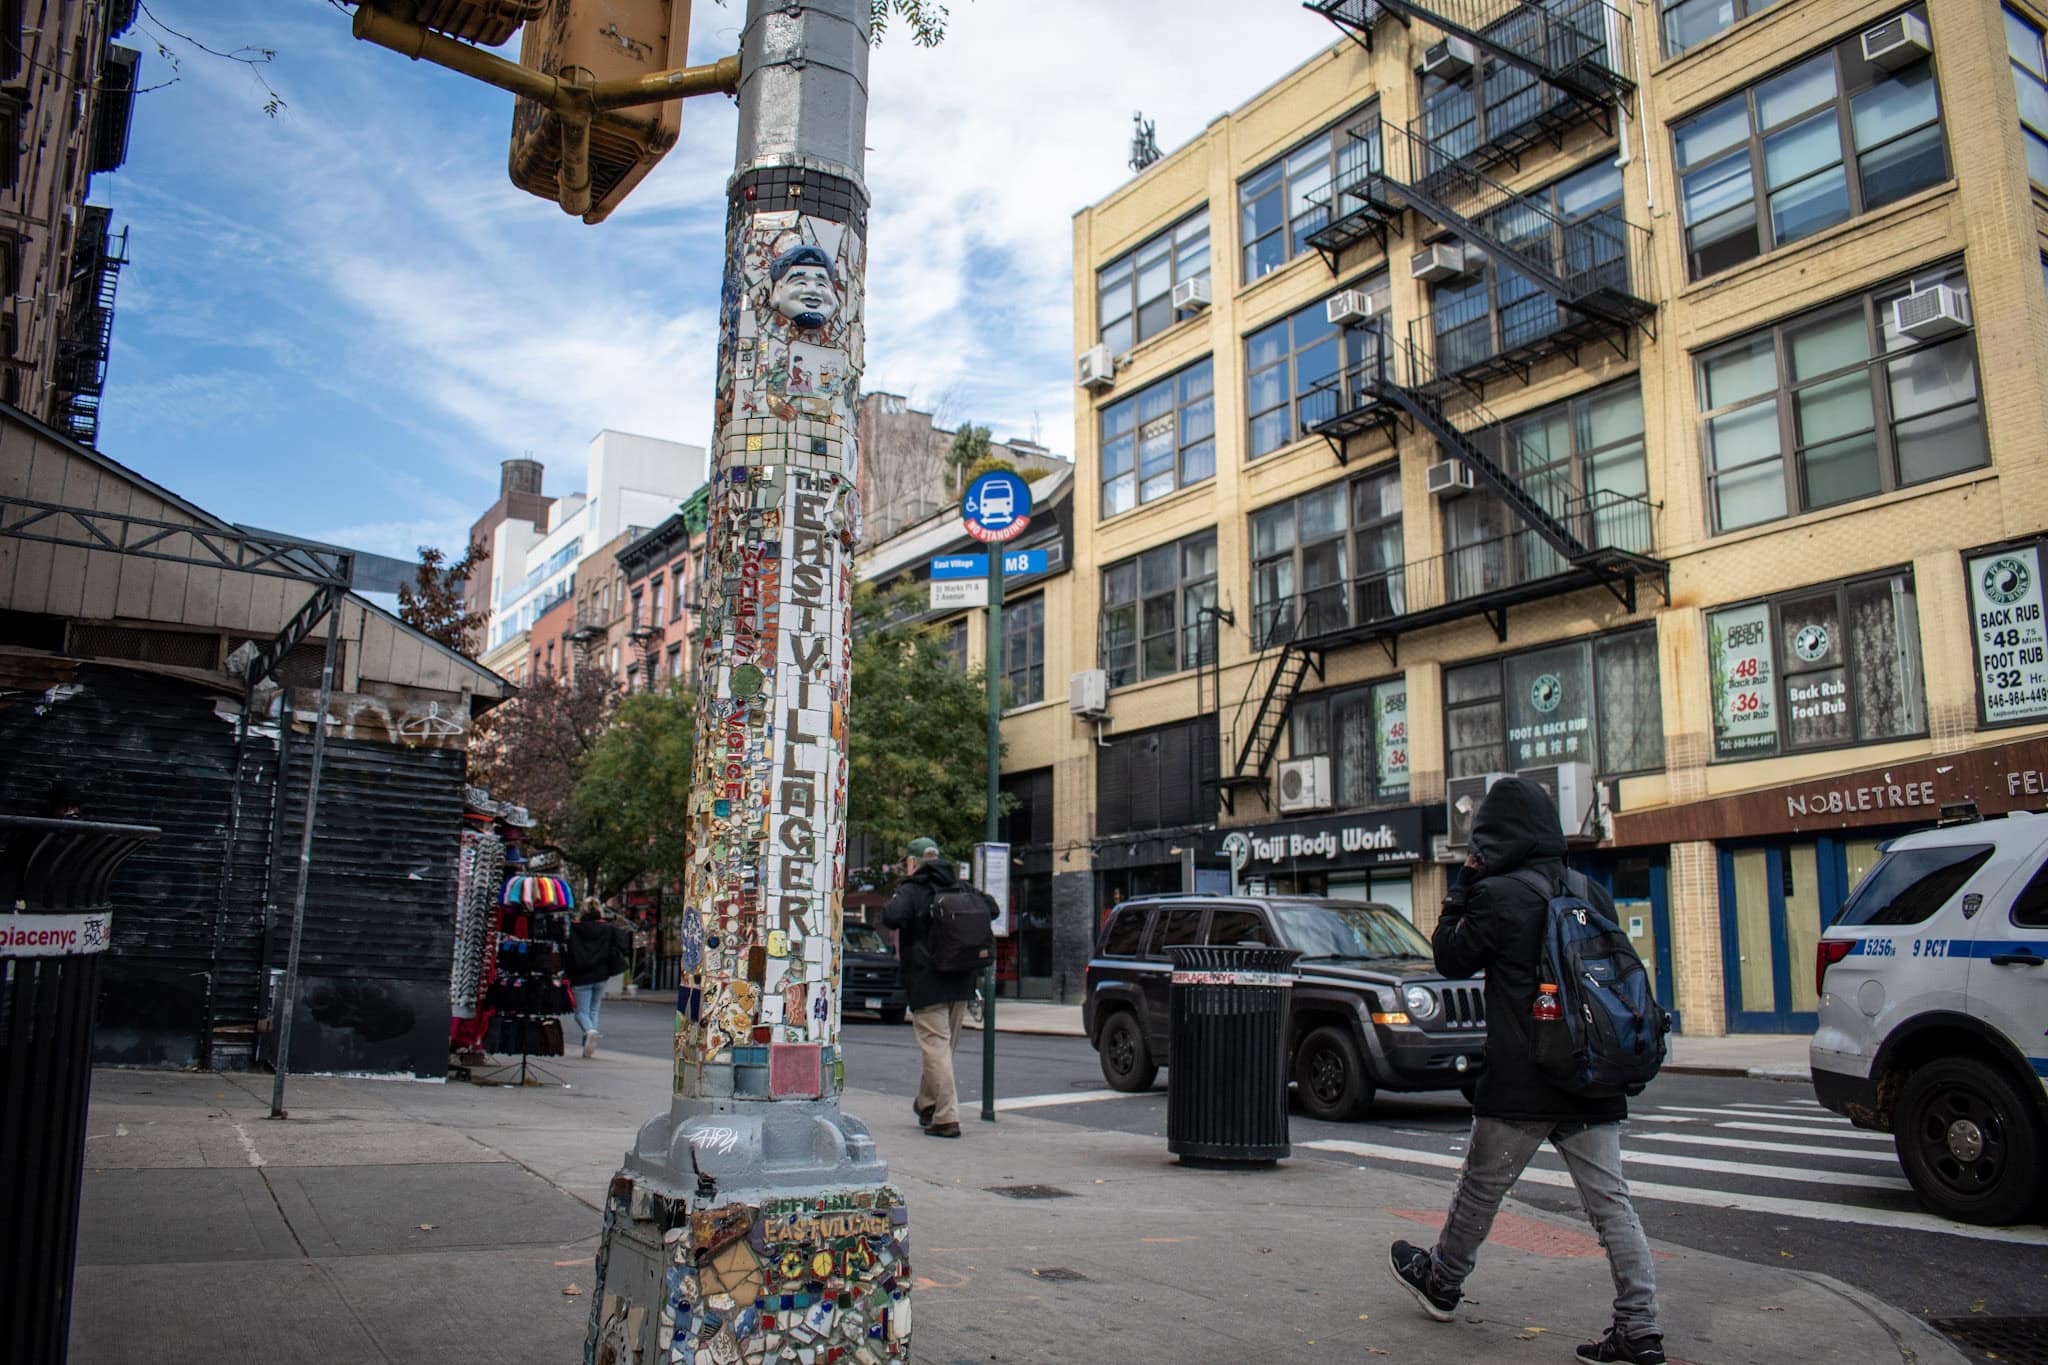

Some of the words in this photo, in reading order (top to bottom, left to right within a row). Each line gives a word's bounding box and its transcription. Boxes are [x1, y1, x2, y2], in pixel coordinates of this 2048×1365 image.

[967, 520, 981, 535] NO
[980, 518, 1026, 541] STANDING
[934, 561, 949, 569] East
[951, 560, 974, 570] Village
[1005, 554, 1029, 572] M8
[1981, 608, 2012, 629] BACK
[2015, 604, 2040, 623] RUB
[1984, 652, 2015, 671] FOOT
[2018, 647, 2043, 666] RUB
[1790, 684, 1819, 701] Back
[1821, 680, 1846, 697] Rub
[1988, 687, 2048, 709] 646-964-449
[1792, 702, 1820, 720] Foot
[1822, 698, 1847, 715] Rub
[1510, 727, 1532, 741] FOOT
[1533, 725, 1542, 738] &
[1543, 721, 1567, 736] BACK
[1568, 717, 1588, 732] RUB
[1787, 781, 1935, 817] NOBLETREE
[1251, 837, 1288, 864] Taiji
[1290, 833, 1337, 860] Body
[1342, 824, 1394, 851] Work
[1866, 938, 1892, 956] 5256
[1912, 938, 1921, 957] 9
[1924, 938, 1948, 957] PCT
